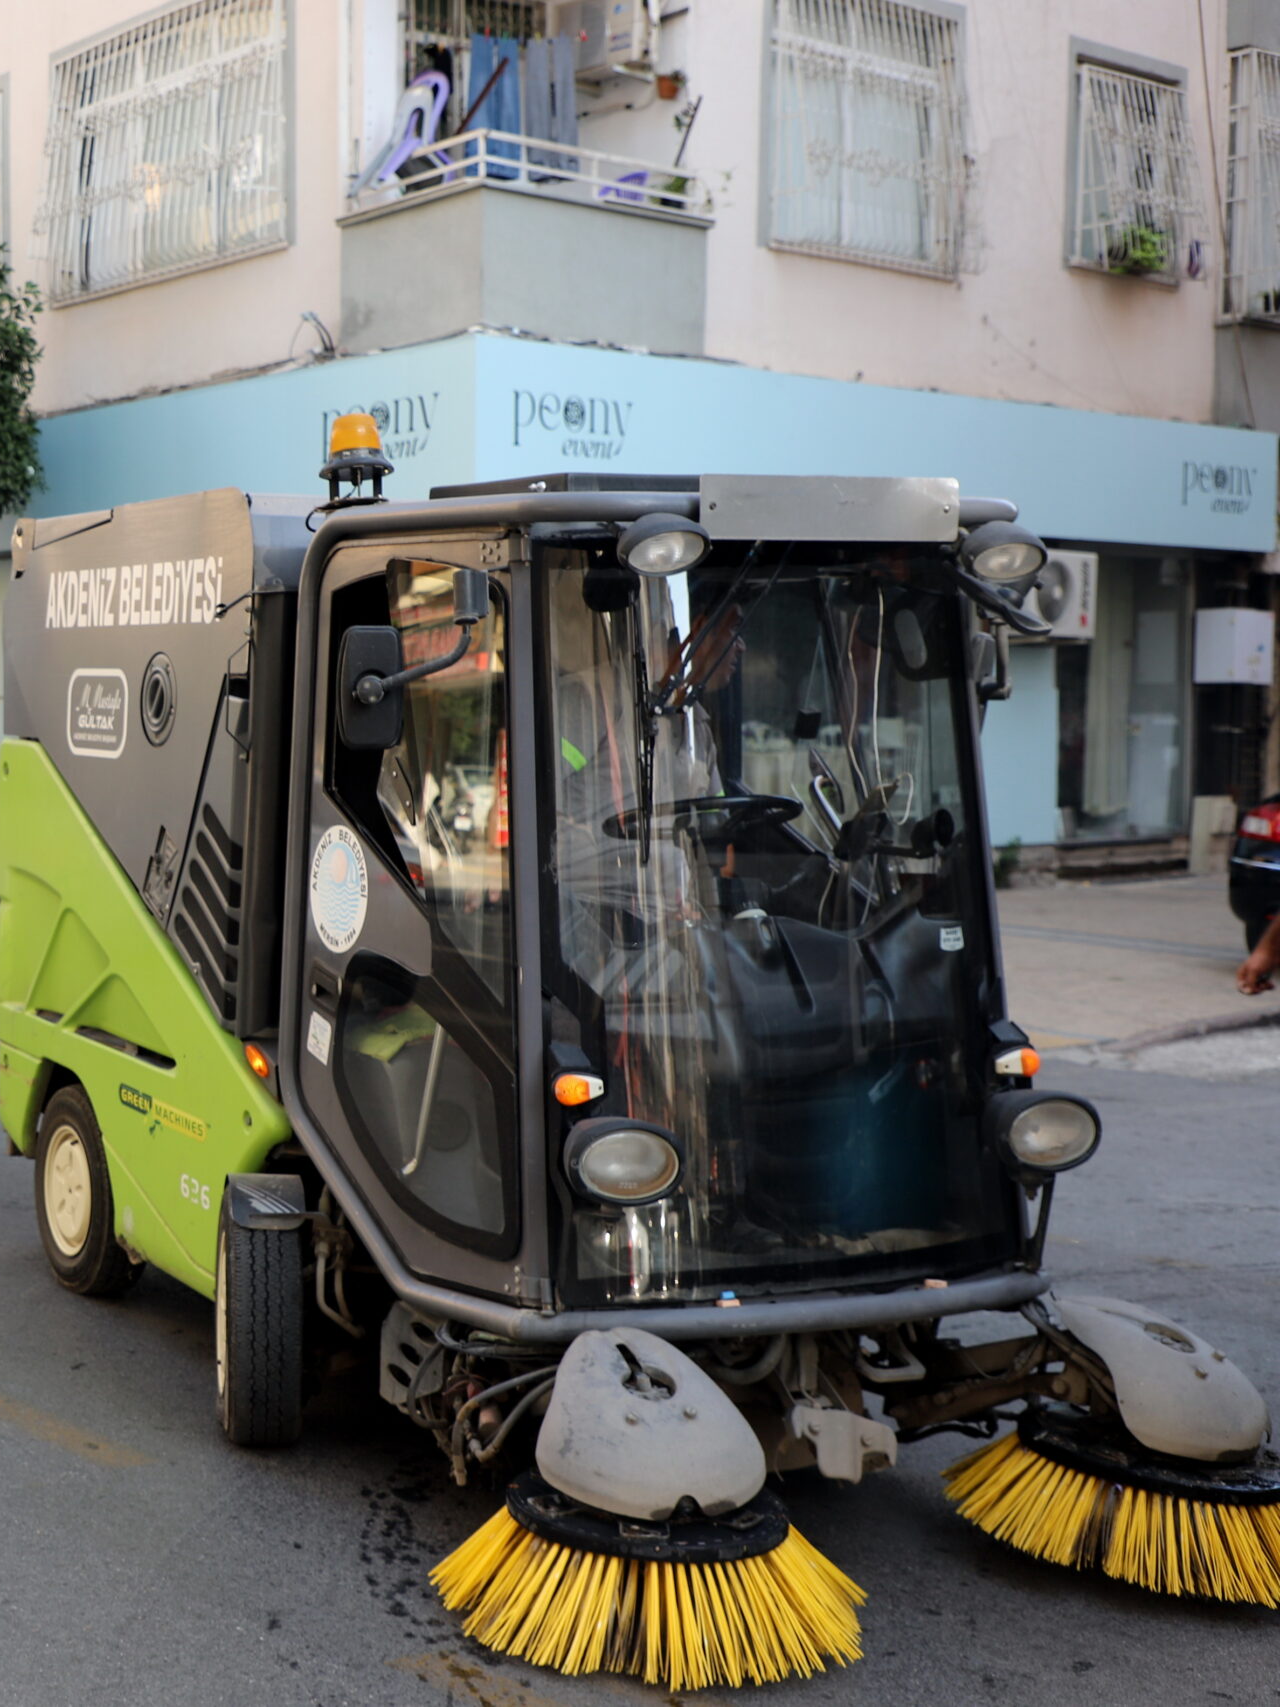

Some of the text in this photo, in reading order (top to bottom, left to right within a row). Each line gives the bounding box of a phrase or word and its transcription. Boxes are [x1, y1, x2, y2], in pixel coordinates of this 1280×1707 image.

[321, 391, 439, 464] pony
[513, 389, 633, 456] peony
[561, 438, 614, 460] event
[120, 1087, 204, 1137] GREEN MACHINES
